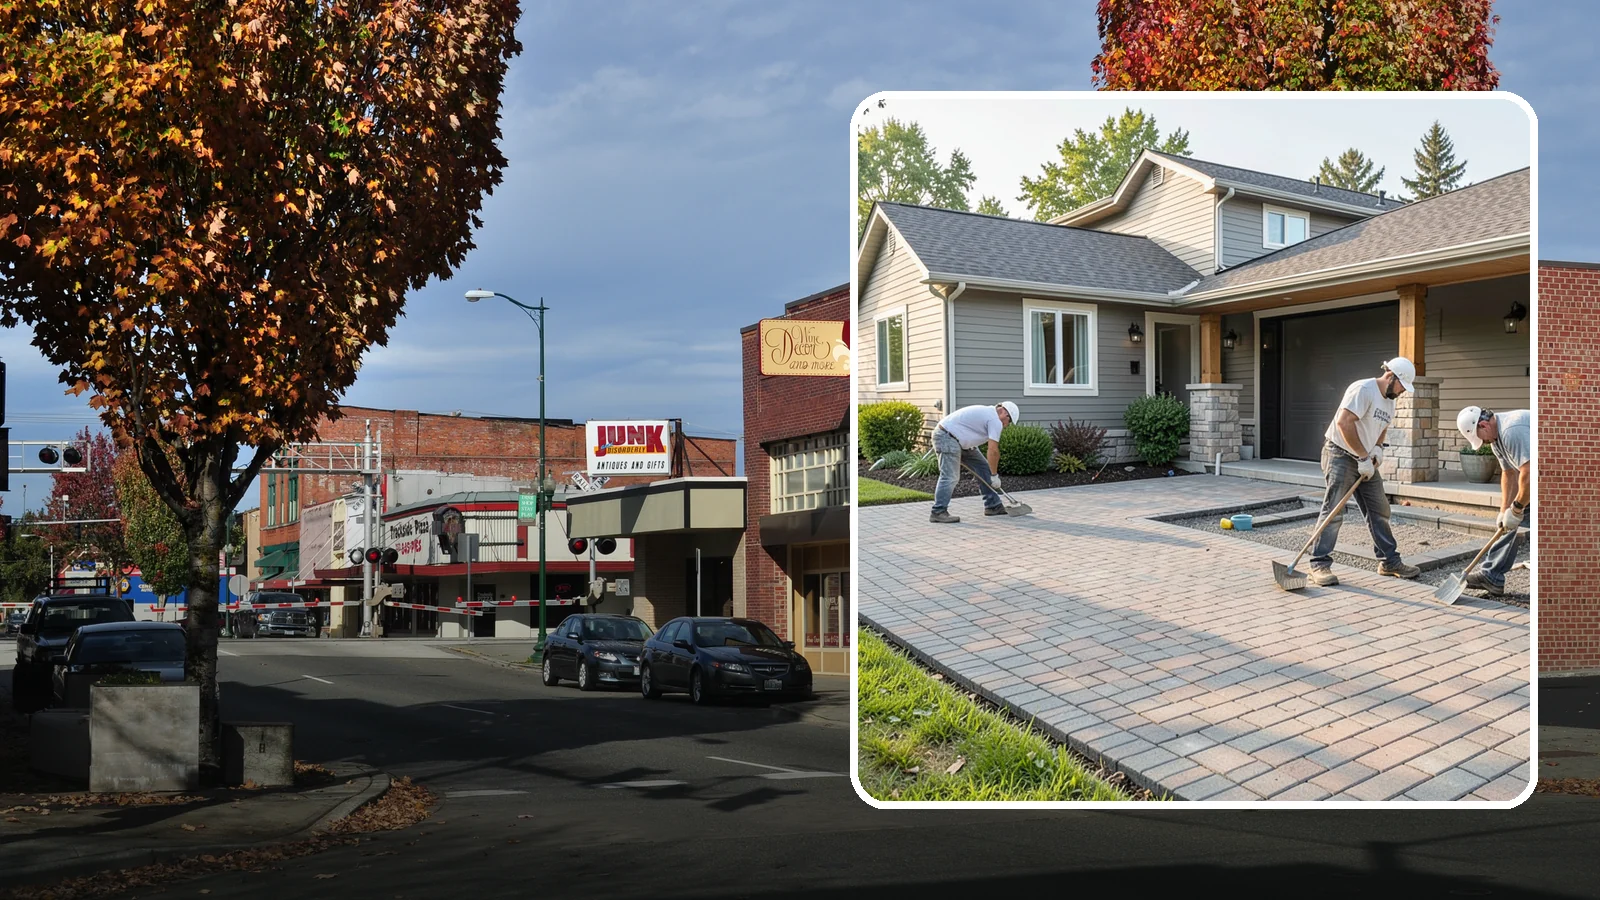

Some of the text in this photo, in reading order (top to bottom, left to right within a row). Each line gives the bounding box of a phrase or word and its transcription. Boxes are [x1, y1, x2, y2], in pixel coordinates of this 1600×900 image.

[595, 425, 665, 457] JUNK
[607, 446, 646, 454] DISORDERLY
[597, 460, 666, 470] ANTIQUES AND GIFTS
[390, 519, 429, 540] Trackside Pizza
